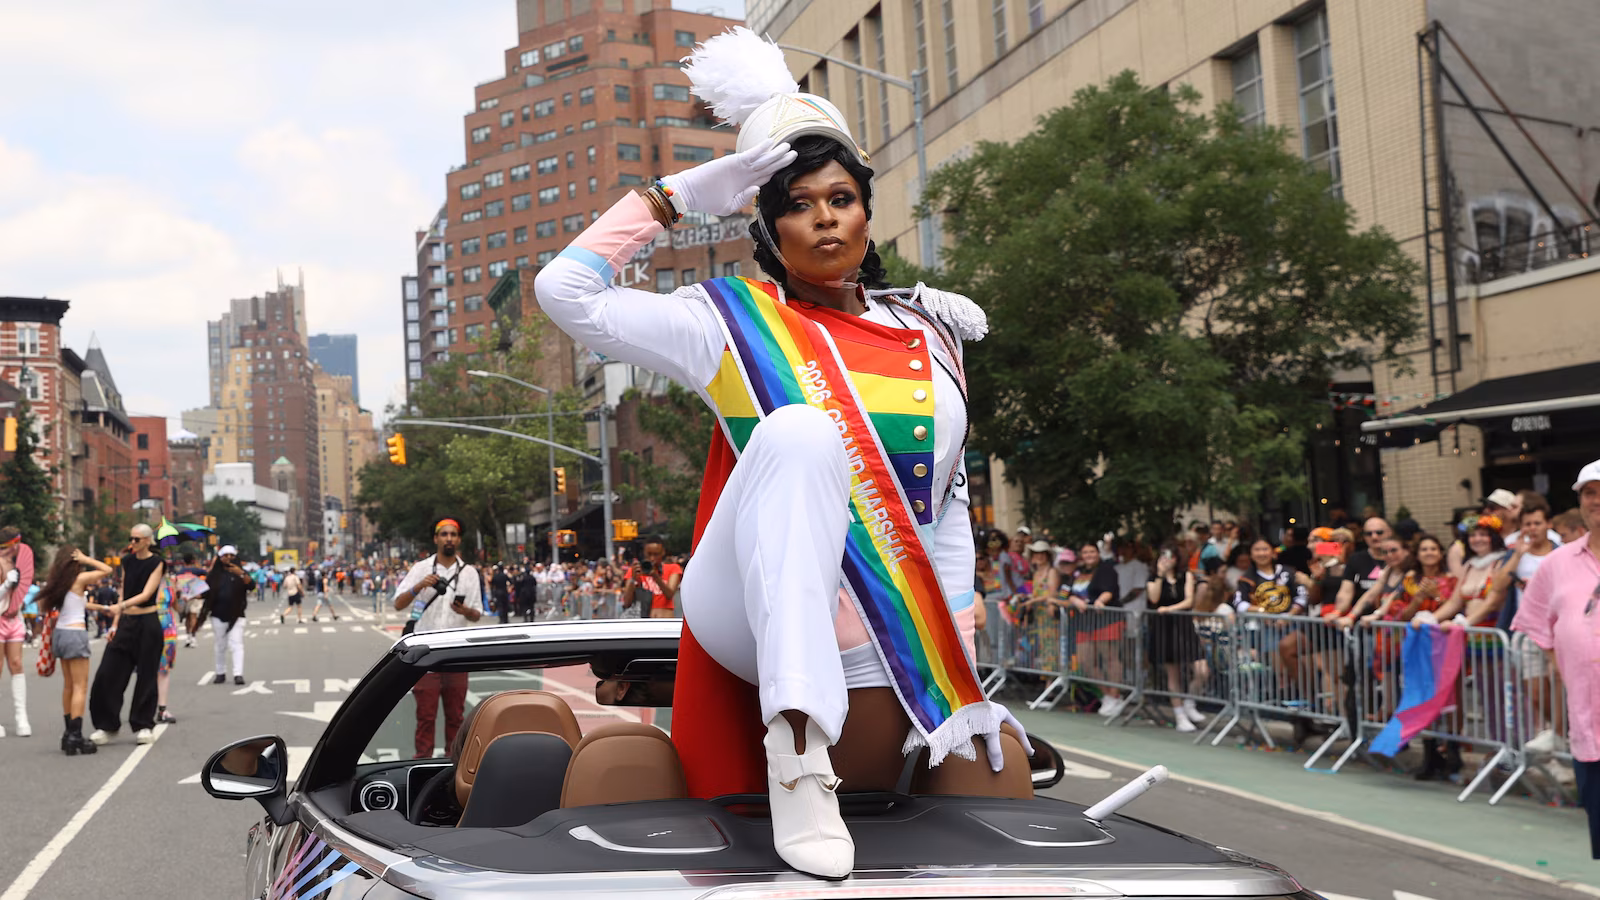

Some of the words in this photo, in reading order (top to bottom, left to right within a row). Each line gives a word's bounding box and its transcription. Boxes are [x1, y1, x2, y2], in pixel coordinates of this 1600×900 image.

[612, 262, 650, 287] CK
[796, 360, 831, 404] 2026
[853, 479, 908, 573] MARSHAL
[230, 679, 361, 695] NLY
